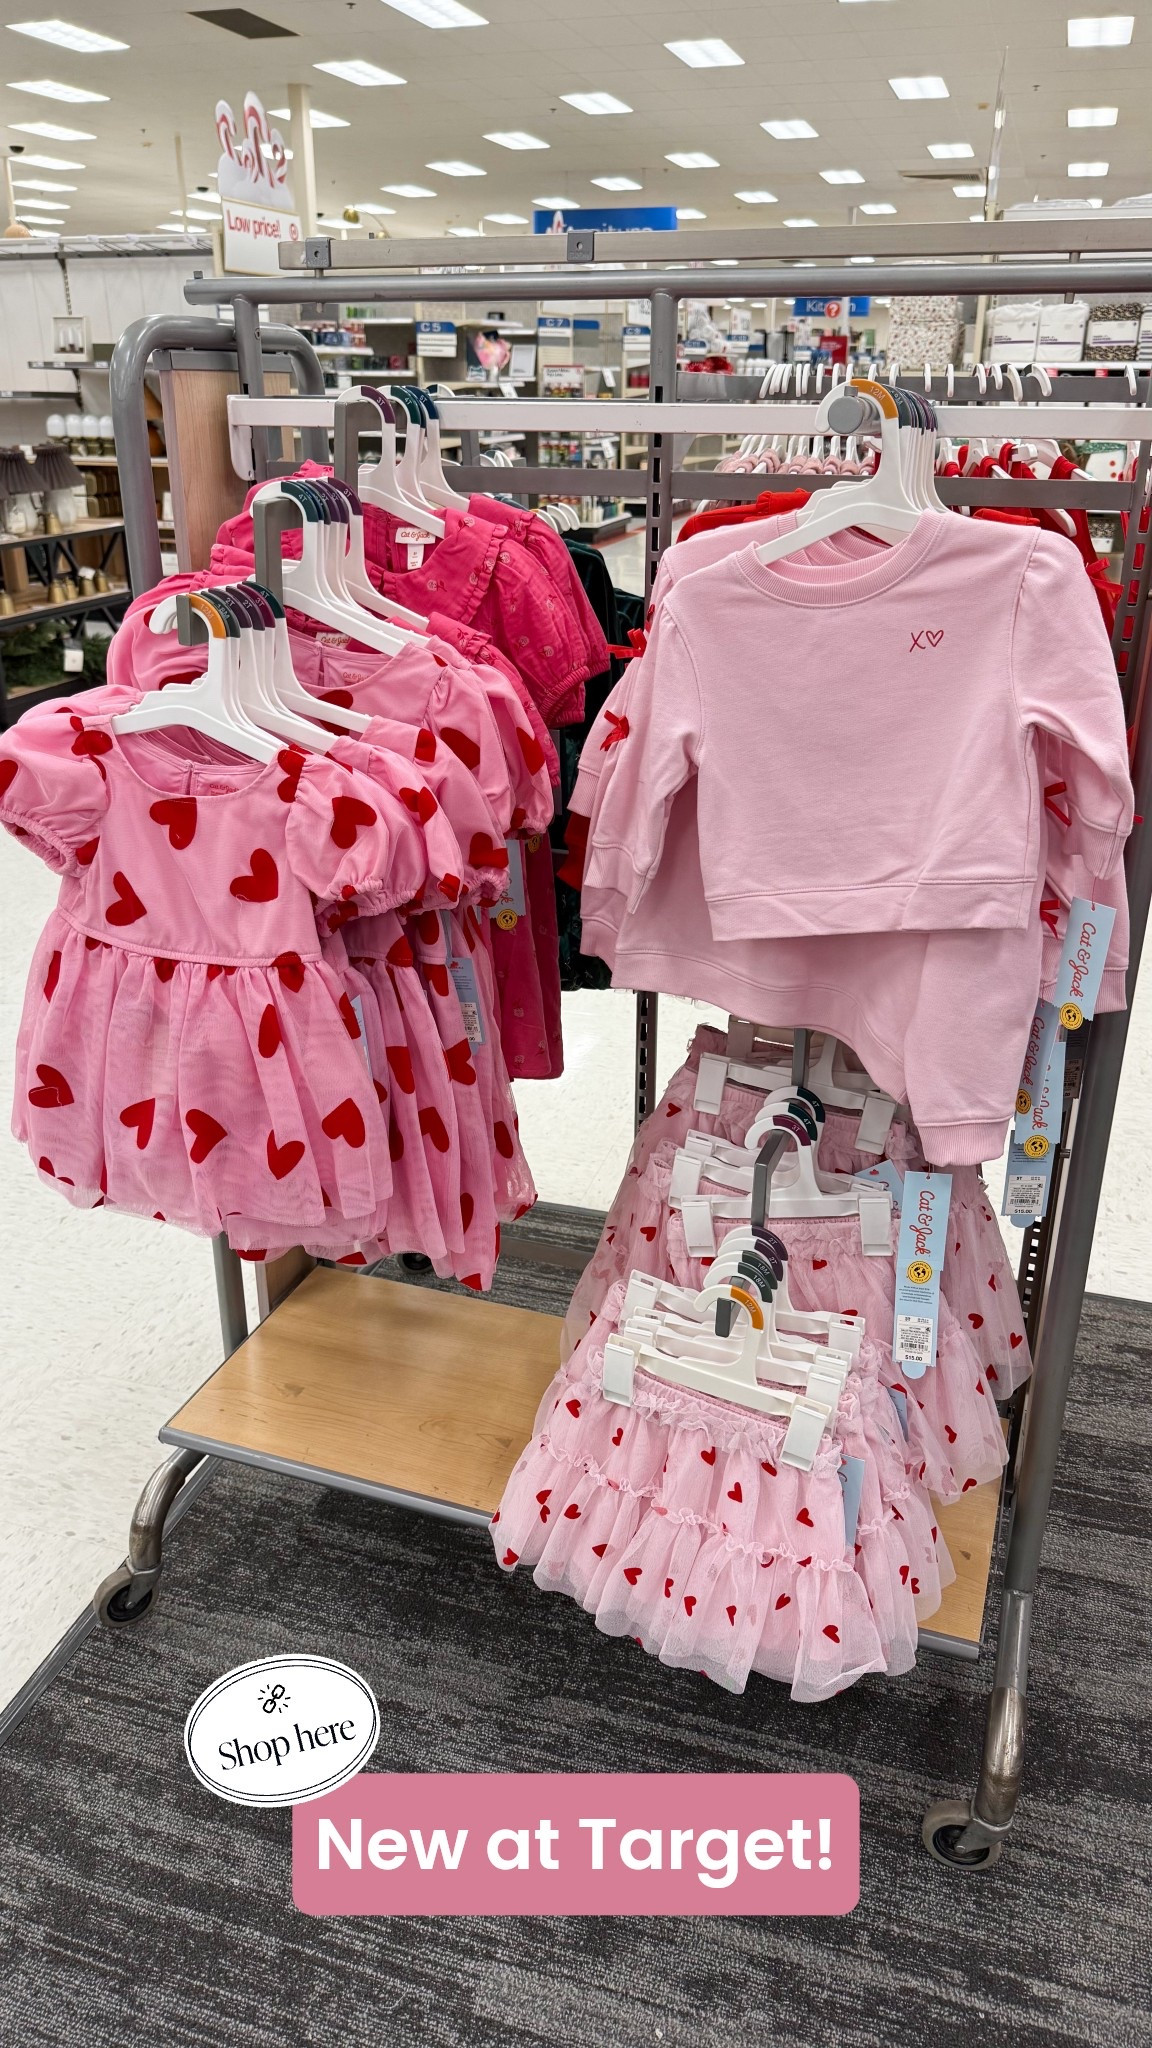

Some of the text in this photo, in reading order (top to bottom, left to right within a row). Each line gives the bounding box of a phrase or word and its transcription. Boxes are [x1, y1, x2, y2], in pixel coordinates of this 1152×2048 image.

[226, 209, 250, 233] Low
[420, 395, 428, 403] 5T
[870, 386, 886, 400] 12M
[376, 396, 386, 406] 3T
[404, 397, 412, 405] 4T
[298, 494, 308, 503] 4T
[343, 488, 352, 498] 3T
[260, 590, 270, 599] 4T
[226, 598, 236, 607] 2T
[244, 600, 253, 609] 2T
[256, 597, 265, 607] 3T
[200, 604, 214, 620] 12M
[1080, 922, 1096, 947] Cat
[1077, 948, 1090, 964] &
[1068, 960, 1088, 998] Jack
[1030, 1016, 1045, 1042] Cat
[792, 1124, 800, 1132] 3T
[920, 1190, 935, 1212] Cat
[918, 1213, 932, 1226] &
[908, 1224, 932, 1256] Jack
[768, 1256, 778, 1264] 2T
[757, 1263, 770, 1276] 18M
[753, 1274, 766, 1288] 18M
[744, 1300, 757, 1314] 12M
